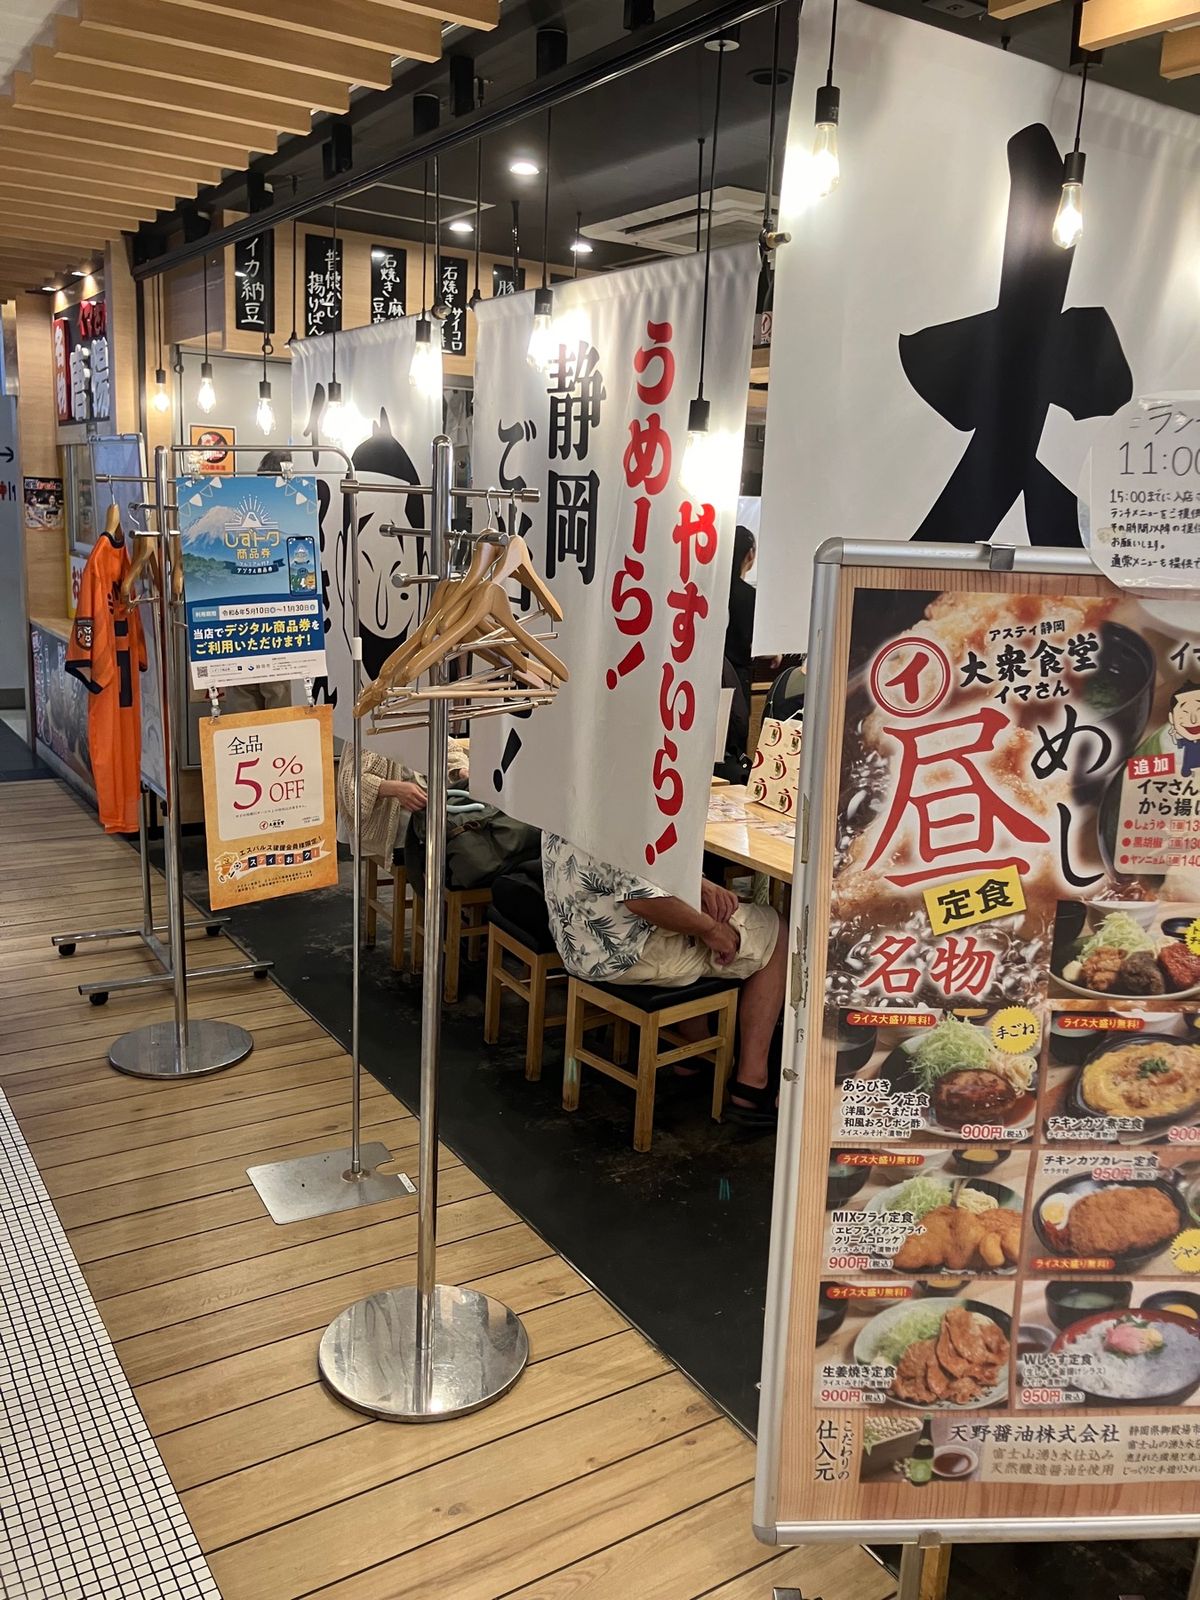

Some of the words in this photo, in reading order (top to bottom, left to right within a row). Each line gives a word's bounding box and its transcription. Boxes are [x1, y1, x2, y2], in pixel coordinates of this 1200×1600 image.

[240, 237, 265, 324] イカ納豆
[380, 254, 400, 297] 石焼き
[388, 298, 405, 320] 麻
[442, 266, 458, 307] 石焼き
[452, 307, 464, 350] サイコロ
[899, 123, 1133, 546] 大
[1148, 405, 1200, 435] ラン
[546, 340, 606, 585] 静岡
[606, 320, 676, 690] うめーら！
[1110, 489, 1200, 503] 15:00までに入店
[237, 548, 271, 560] 商品券
[193, 618, 320, 640] 当店でデジタル商品券を
[196, 635, 312, 656] ご利用いただけます！
[959, 632, 1100, 689] 大衆食堂
[993, 679, 1070, 705] イマさん
[228, 735, 264, 756] 全品
[272, 754, 304, 778] %
[1134, 756, 1170, 776] 追加
[232, 757, 263, 811] 5
[268, 778, 305, 802] OFF
[1030, 703, 1112, 887] めし
[862, 706, 1051, 887] 昼
[936, 878, 1015, 925] 定食
[859, 935, 996, 996] 名物
[995, 1023, 1036, 1040] 手ごね
[842, 1079, 891, 1093] あらびき
[842, 1093, 930, 1107] ハンバーグ定食
[961, 1125, 1002, 1140] 900円
[1169, 1126, 1200, 1140] 900
[1044, 1154, 1158, 1167] チキンカツカレー定食
[1092, 1166, 1133, 1180] 950円
[832, 1210, 914, 1224] MIXフライ定食
[829, 1257, 869, 1269] 900円
[1023, 1353, 1094, 1366] Wしらす定食
[822, 1365, 896, 1379] 生姜焼き定食
[821, 1389, 861, 1402] 900円
[1022, 1389, 1061, 1403] 950円
[814, 1419, 839, 1481] 仕入元
[837, 1420, 855, 1480] こだわりの
